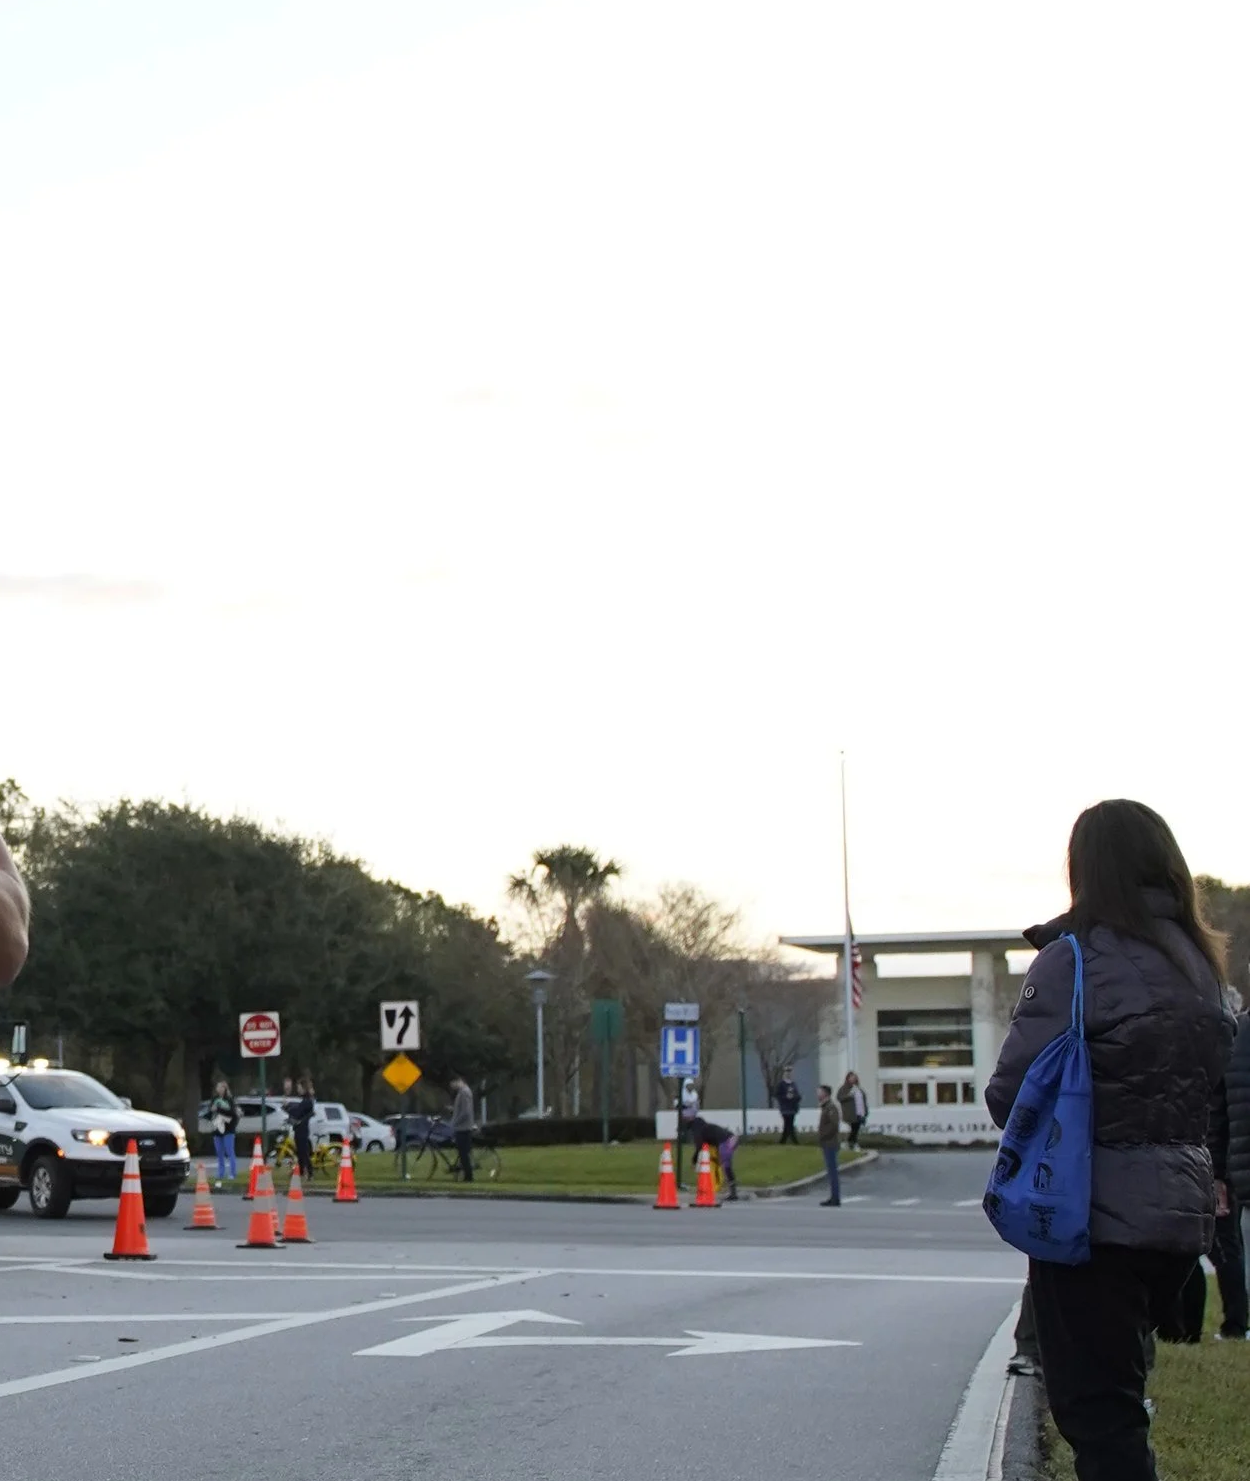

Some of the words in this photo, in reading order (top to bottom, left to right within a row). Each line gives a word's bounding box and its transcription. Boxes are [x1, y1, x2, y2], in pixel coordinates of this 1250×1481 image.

[260, 1021, 272, 1029] NOT
[250, 1039, 271, 1048] ENTER
[667, 1029, 695, 1065] H
[897, 1123, 955, 1134] OSCEOLA
[958, 1123, 997, 1134] LIBRA
